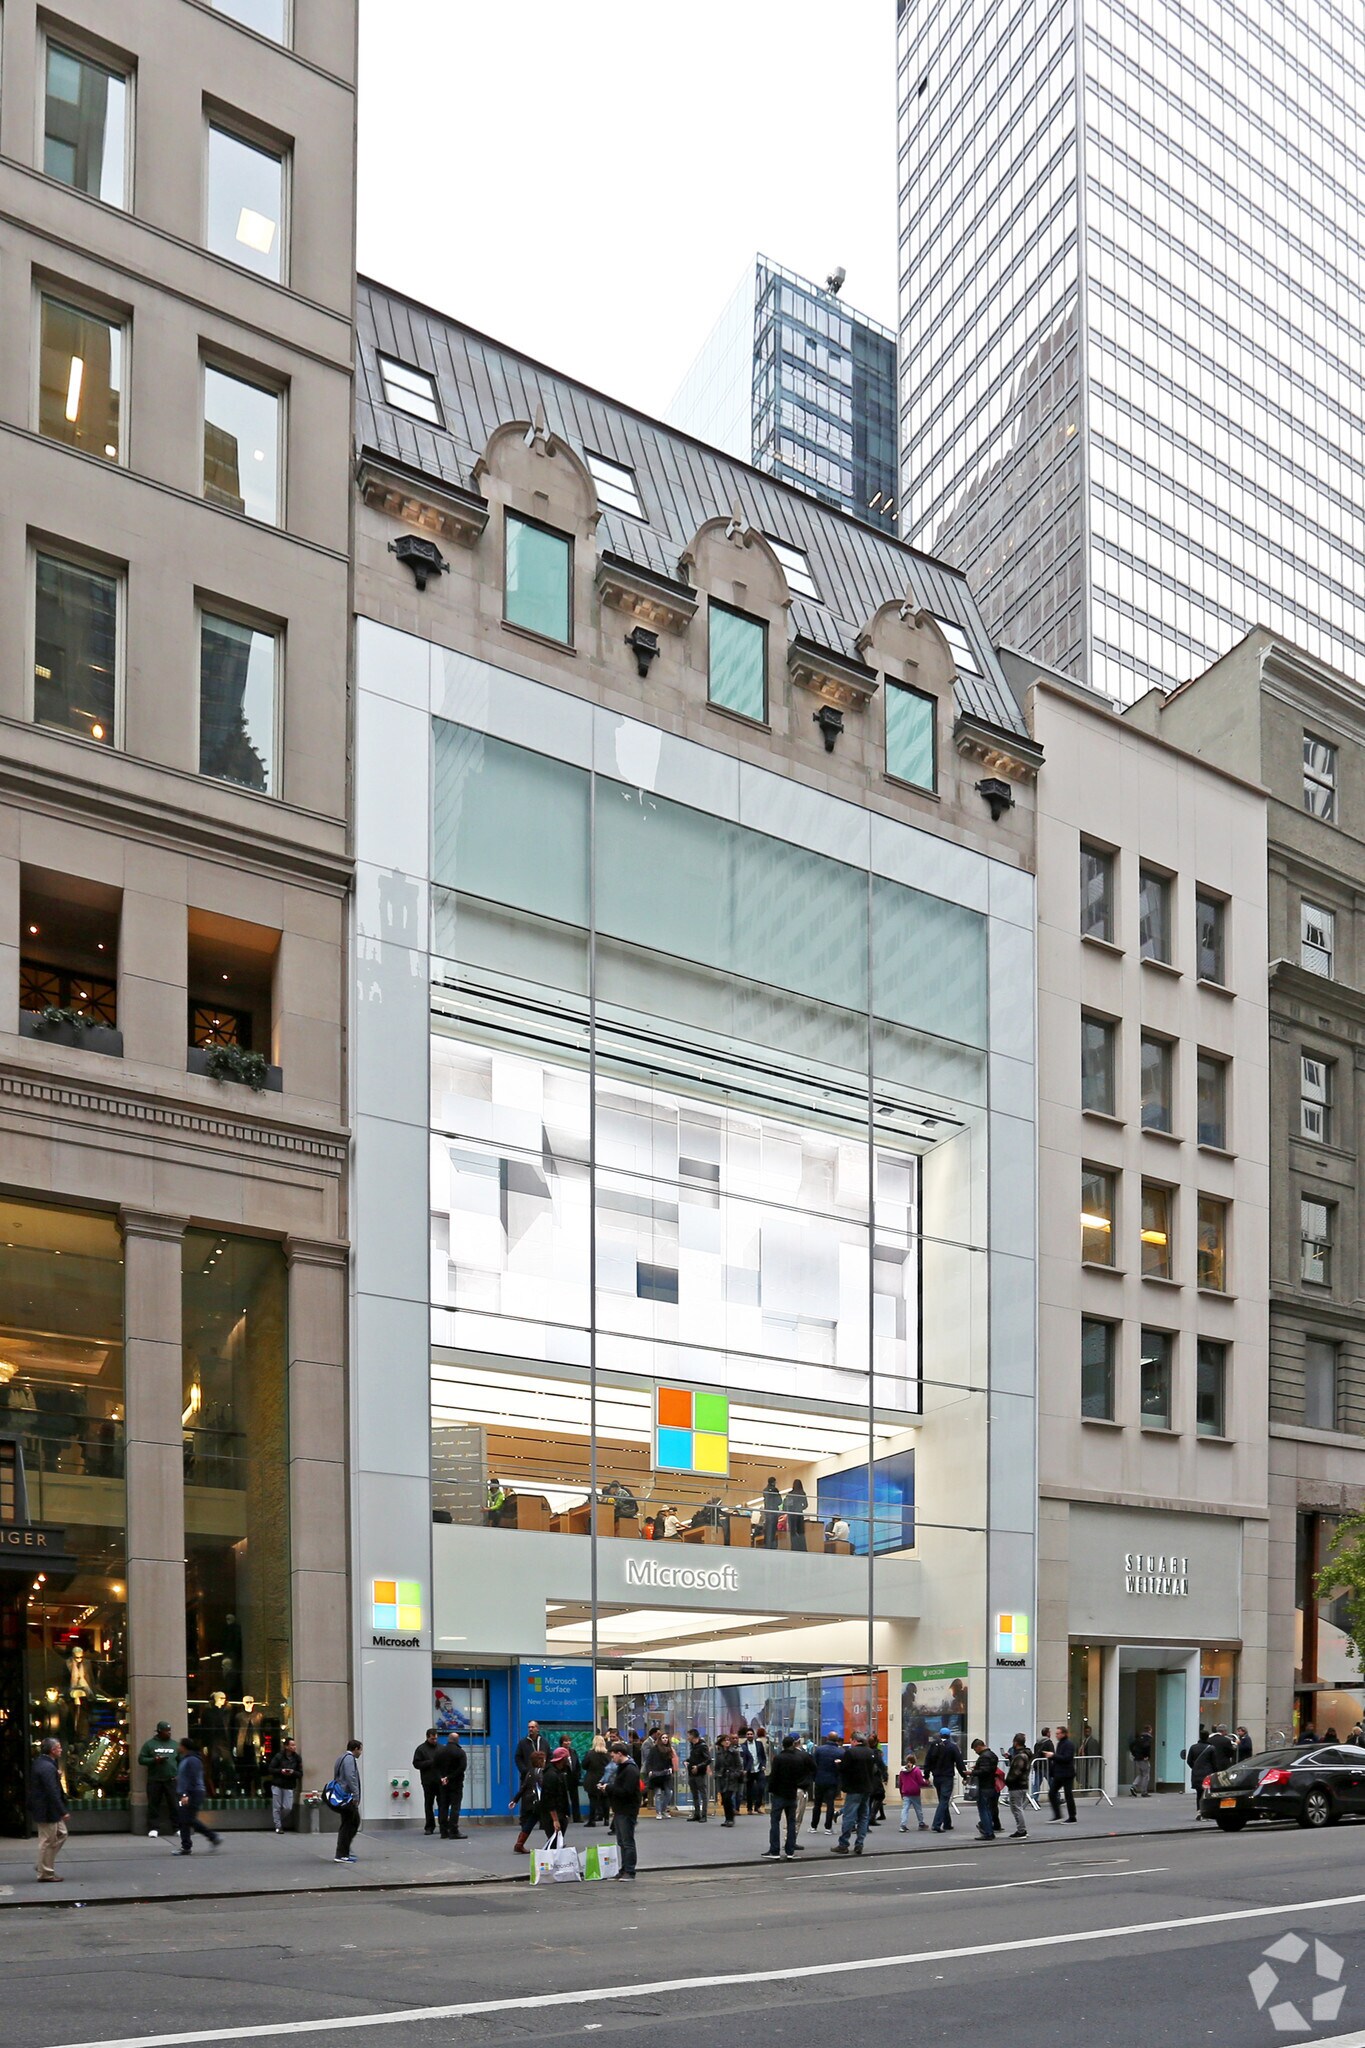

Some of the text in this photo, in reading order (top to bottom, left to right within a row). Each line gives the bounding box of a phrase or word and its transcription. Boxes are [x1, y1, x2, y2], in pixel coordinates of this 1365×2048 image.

[0, 1531, 47, 1546] IGER
[1125, 1554, 1189, 1575] STUART
[626, 1559, 738, 1591] Microsoft
[1125, 1575, 1189, 1596] WEITZMAN
[373, 1635, 420, 1647] Microsoft
[996, 1658, 1026, 1667] Microsoft
[544, 1677, 578, 1685] Microsoft
[544, 1685, 571, 1693] Surface
